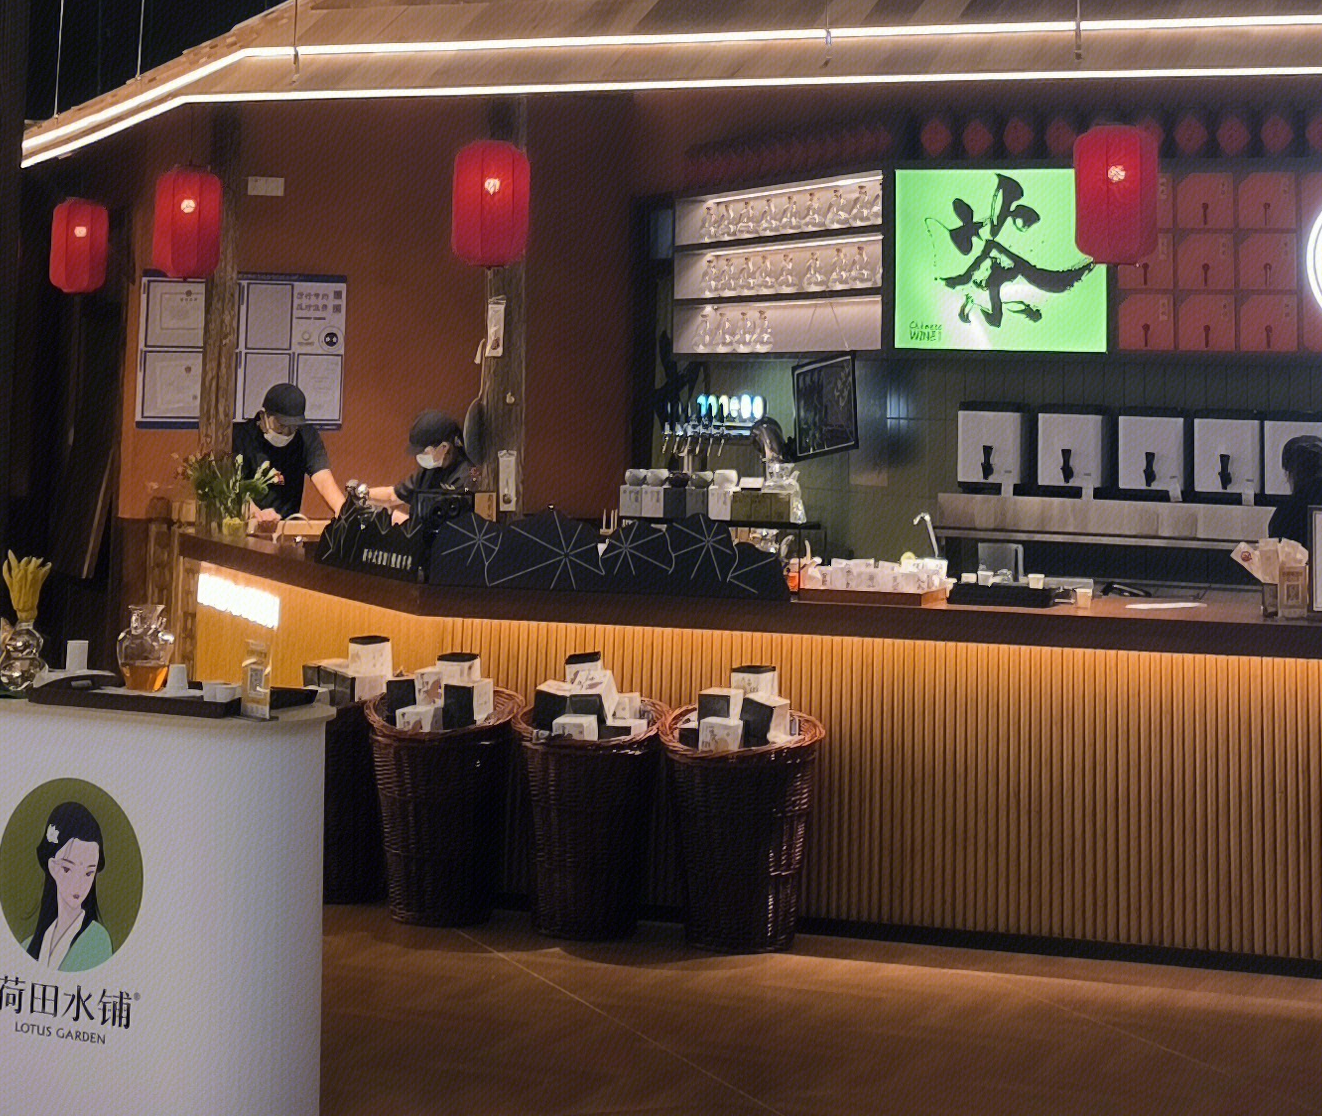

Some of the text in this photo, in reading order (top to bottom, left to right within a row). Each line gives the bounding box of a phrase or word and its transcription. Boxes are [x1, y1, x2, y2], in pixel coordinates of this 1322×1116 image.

[924, 172, 1095, 329] 茶
[14, 1021, 106, 1045] LOTUS GARDEN
